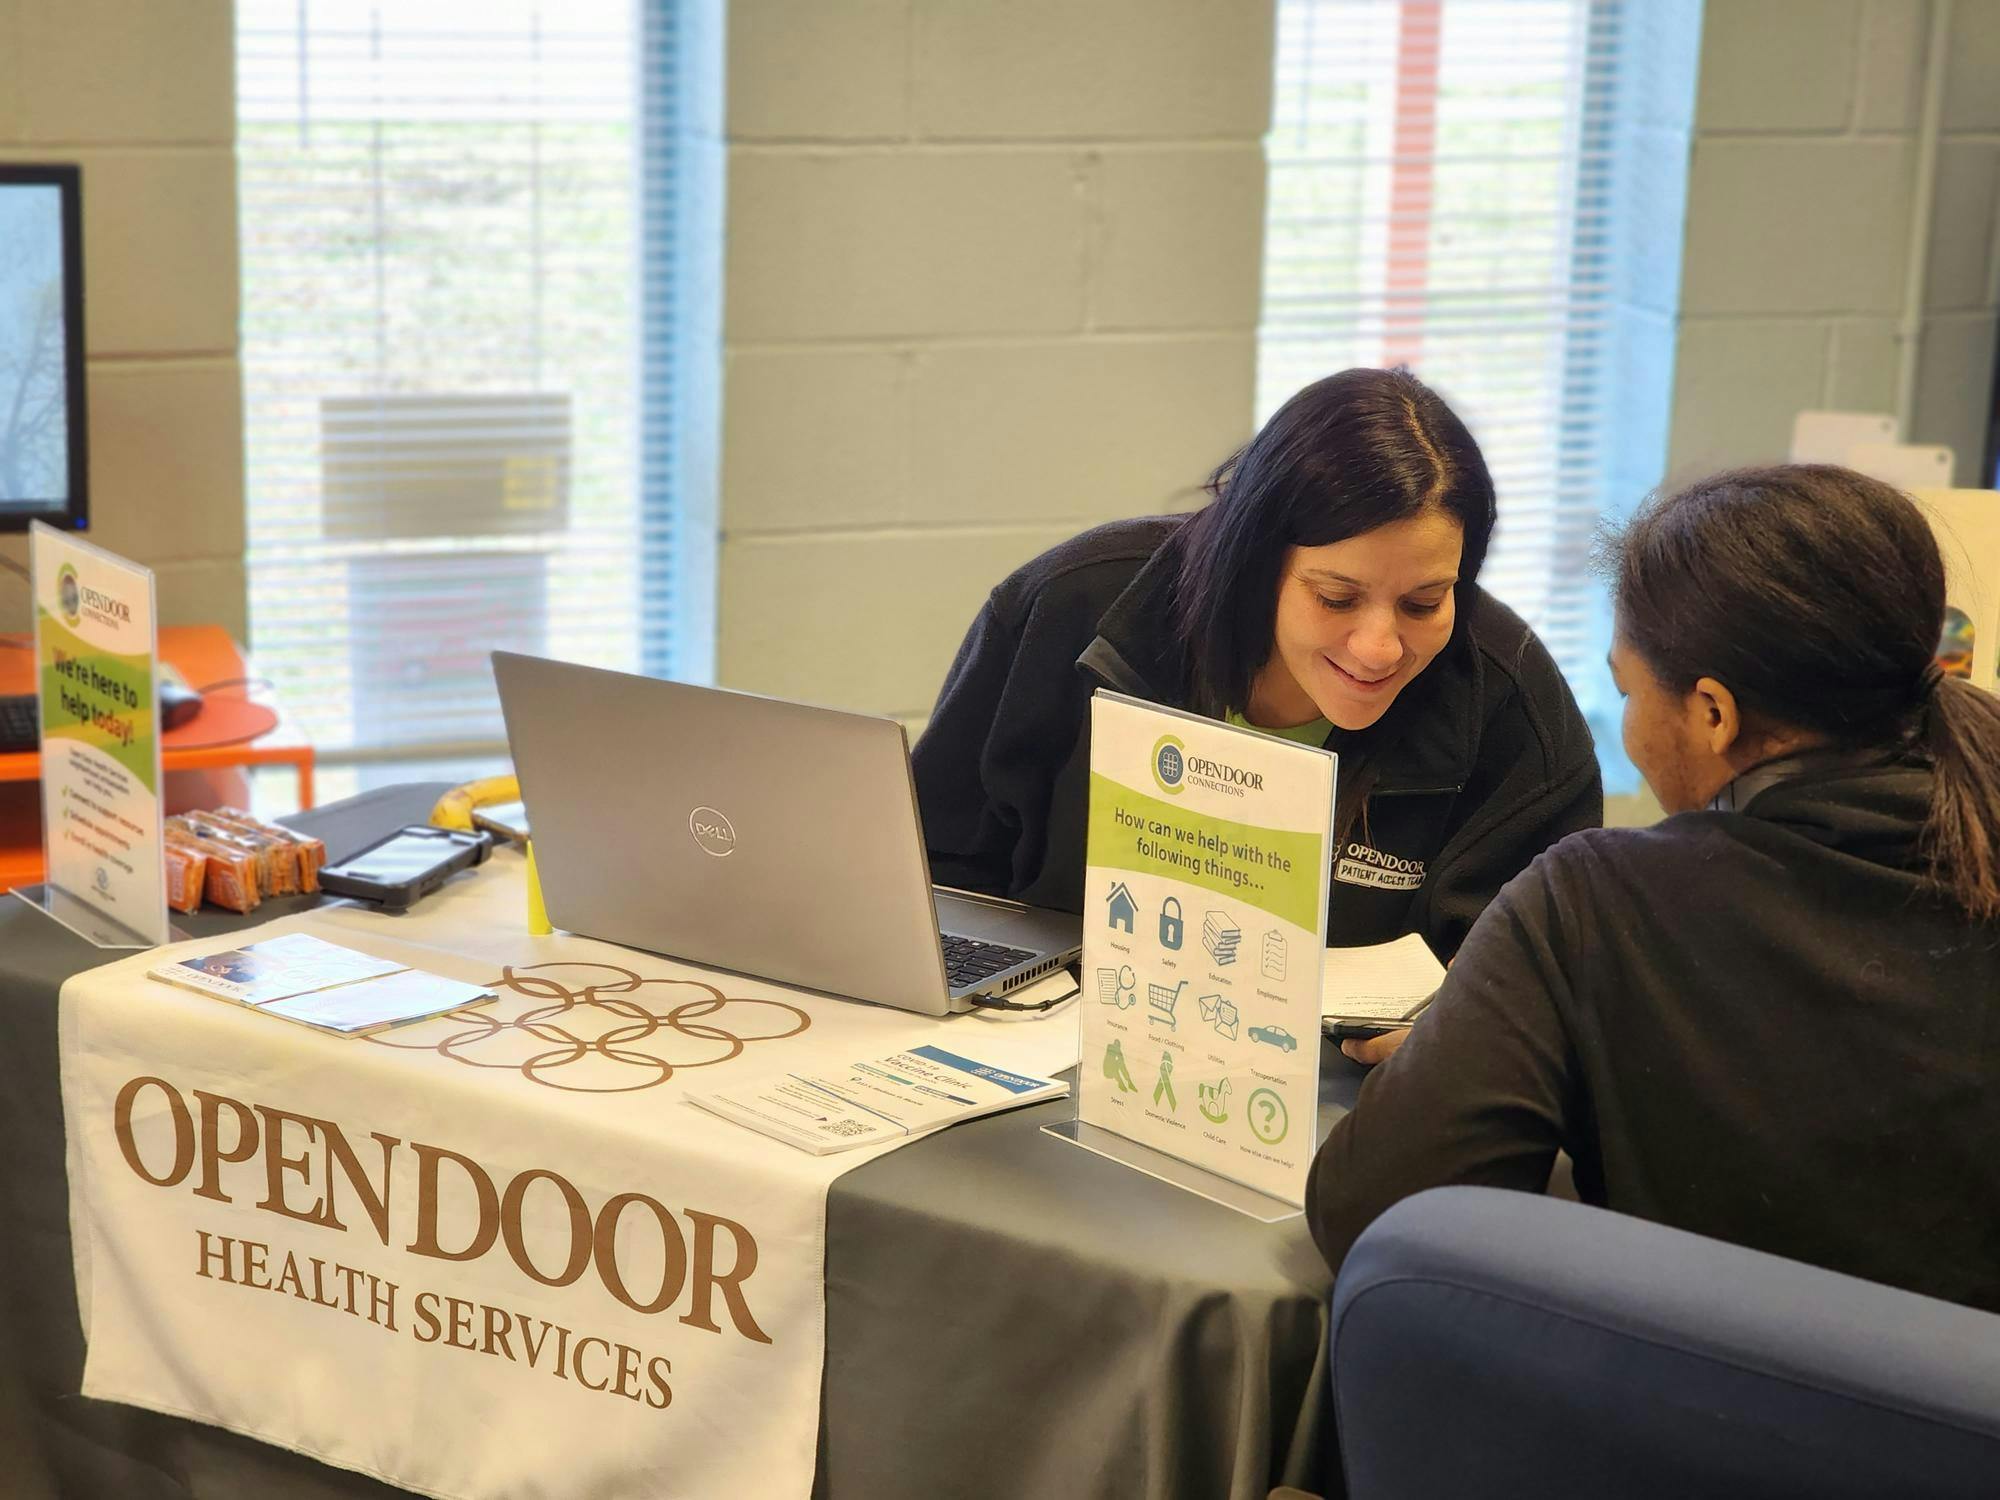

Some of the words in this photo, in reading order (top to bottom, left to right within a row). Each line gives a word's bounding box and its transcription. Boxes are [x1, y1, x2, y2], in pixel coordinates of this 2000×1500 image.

[52, 646, 88, 685] We're
[91, 665, 120, 701] here
[122, 682, 138, 710] to
[61, 684, 90, 726] help
[91, 703, 134, 747] today!
[1187, 775, 1245, 798] CONNECTIONS
[1115, 807, 1145, 830] How
[1149, 820, 1171, 838] can
[1175, 827, 1195, 845] we
[1198, 830, 1228, 858] help
[1232, 844, 1264, 865] with
[1267, 850, 1291, 873] the
[1137, 837, 1201, 876] following
[1204, 858, 1265, 890] things...
[1341, 864, 1377, 882] PATIENT
[1378, 872, 1405, 886] ACCESS
[1110, 942, 1131, 954] Housing
[1161, 958, 1177, 969] Safety
[1208, 972, 1233, 986] Education
[1256, 988, 1288, 1004] Employment
[1148, 1033, 1161, 1044] Food
[1164, 1038, 1185, 1052] Clothing
[884, 1056, 934, 1077] Vaccine
[934, 1074, 973, 1090] Clinic
[1250, 1068, 1288, 1087] Transportation
[1166, 1117, 1186, 1131] Violence
[1202, 1130, 1215, 1142] Child
[1215, 1135, 1227, 1145] Care
[195, 1230, 400, 1333] HEALTH
[412, 1292, 673, 1411] SERVICES
